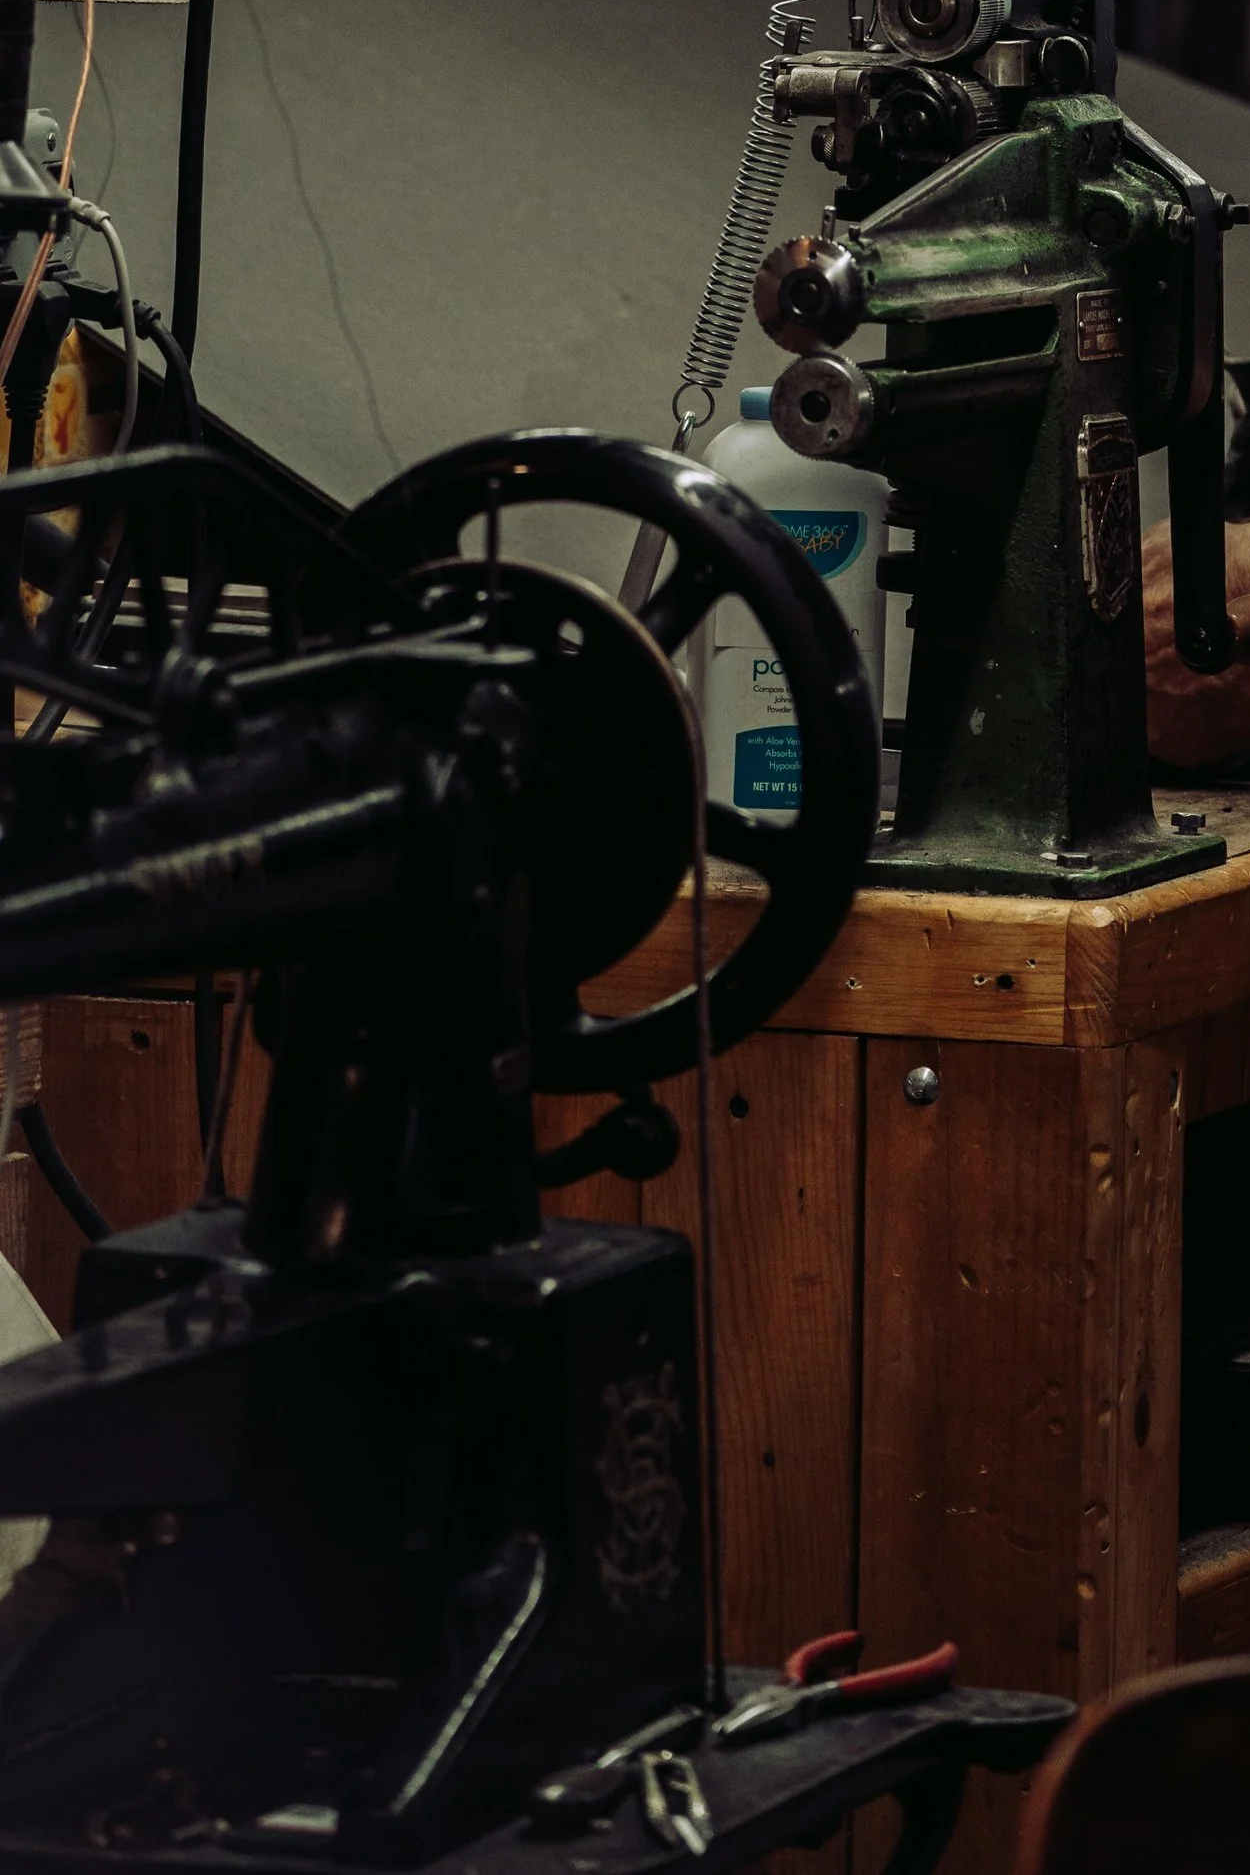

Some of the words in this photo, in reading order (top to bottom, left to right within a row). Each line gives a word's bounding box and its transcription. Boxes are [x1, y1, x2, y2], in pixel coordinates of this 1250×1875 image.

[766, 705, 793, 714] Powder
[747, 735, 763, 745] with
[765, 735, 784, 746] Aloe
[765, 747, 797, 759] Absorbs
[752, 781, 769, 792] NET
[771, 782, 785, 793] WT
[787, 782, 798, 793] 15
